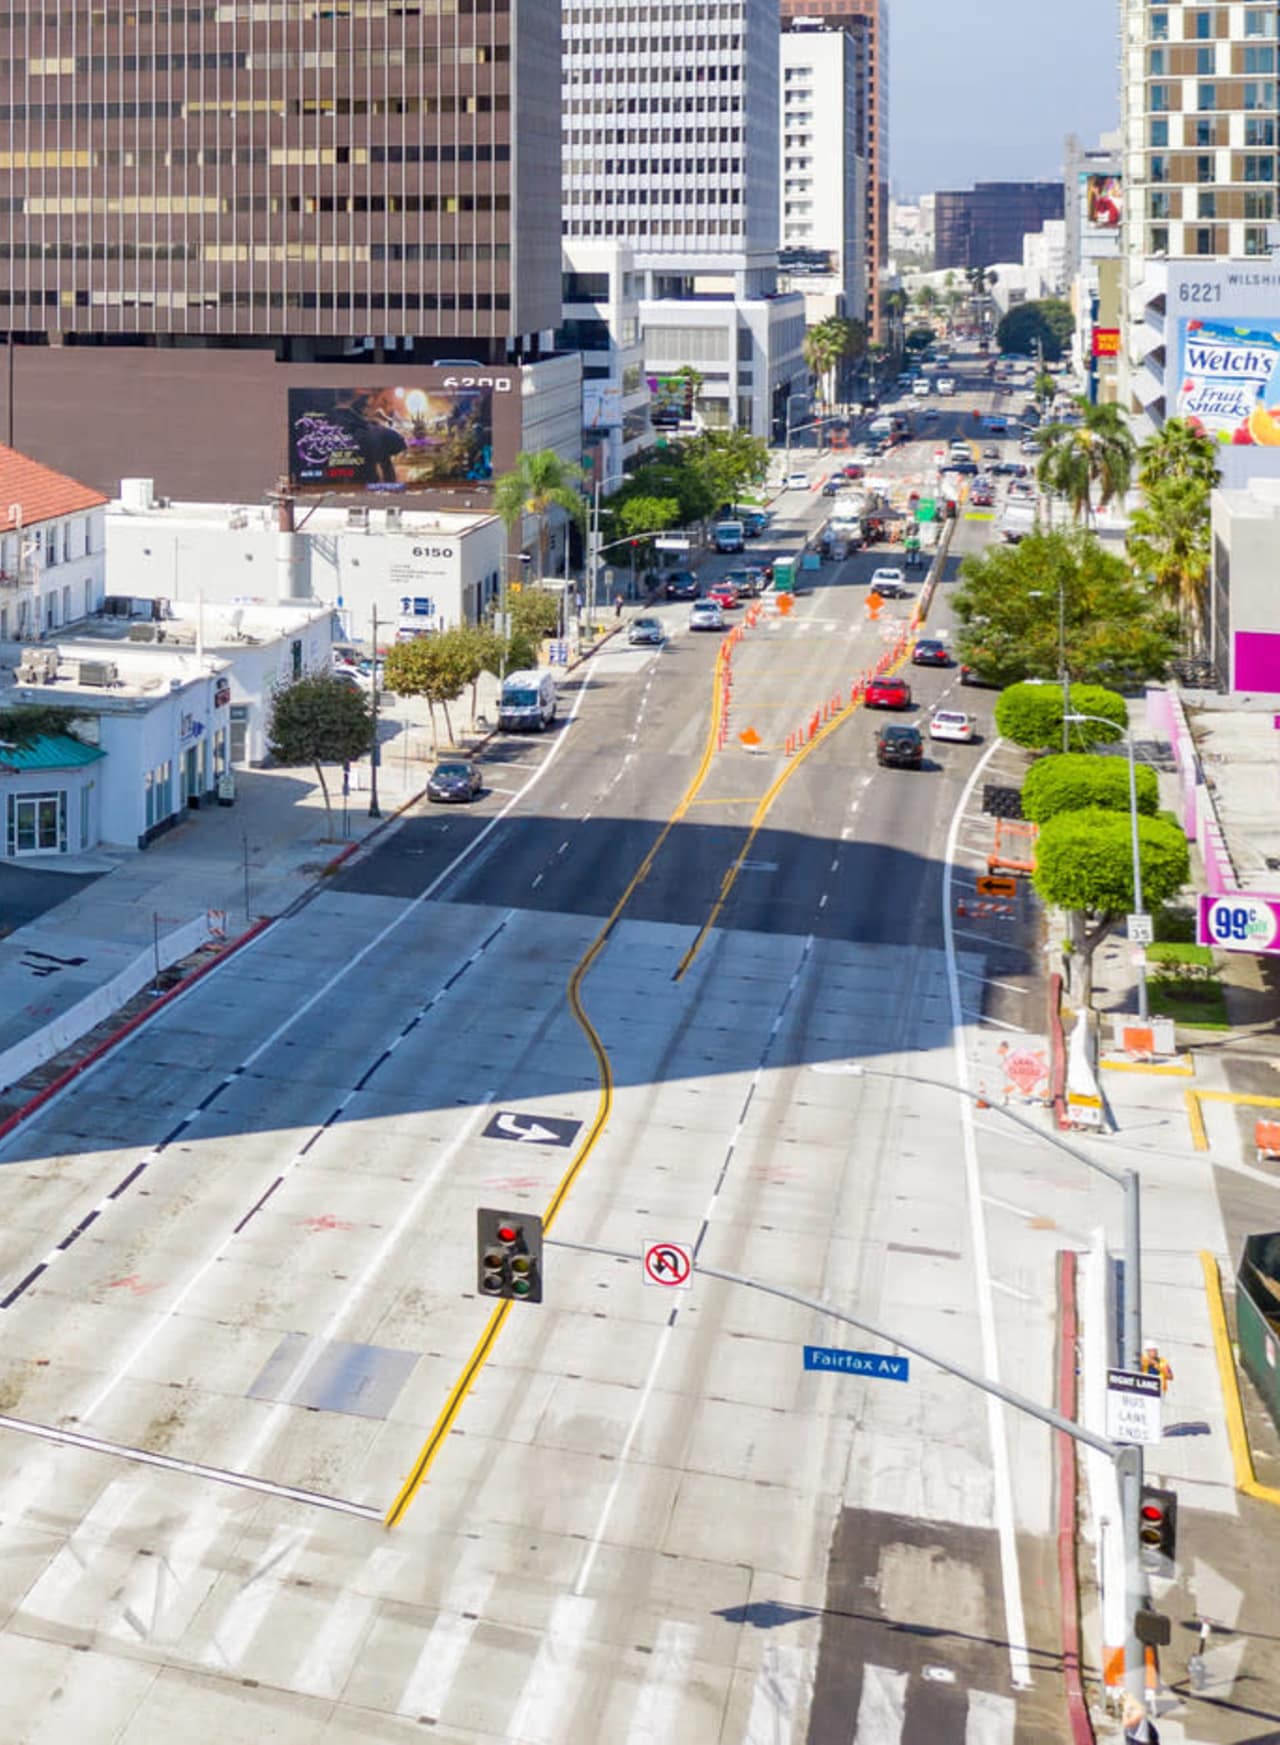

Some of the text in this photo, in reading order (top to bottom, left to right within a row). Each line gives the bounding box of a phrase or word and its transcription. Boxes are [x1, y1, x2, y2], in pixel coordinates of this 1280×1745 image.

[1179, 283, 1221, 303] 6221
[1188, 348, 1273, 374] Welch's
[1199, 386, 1244, 402] Fruit
[1185, 399, 1252, 417] Snacks
[412, 546, 453, 558] 6150
[812, 1351, 900, 1374] Fairfax Av
